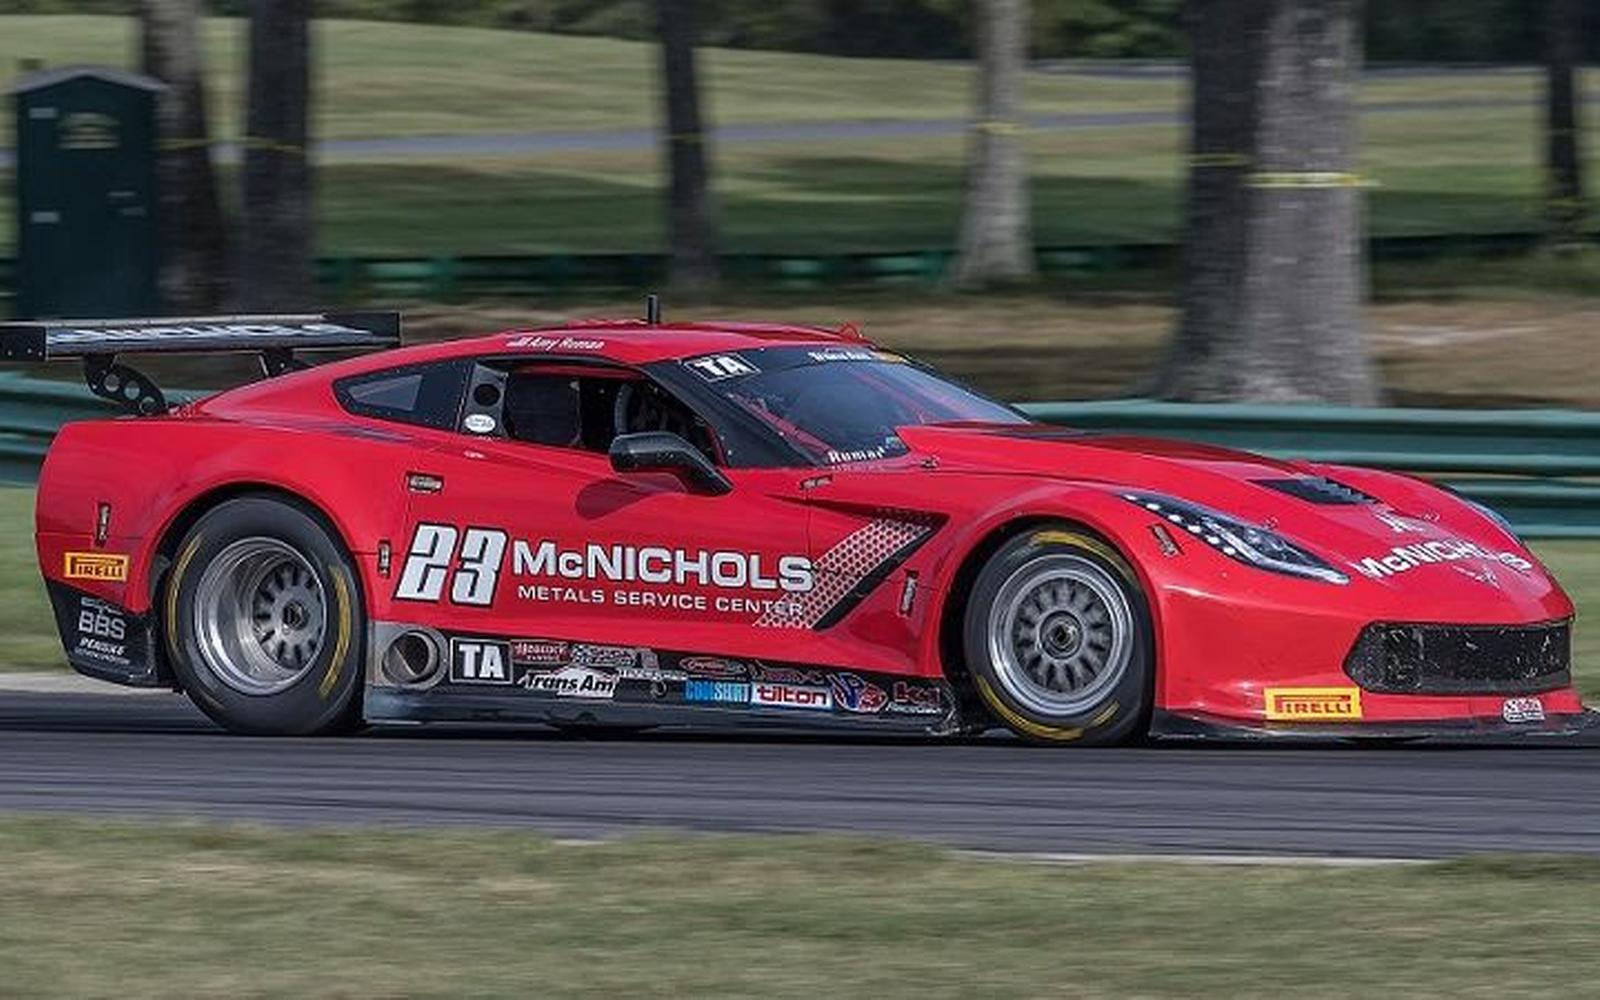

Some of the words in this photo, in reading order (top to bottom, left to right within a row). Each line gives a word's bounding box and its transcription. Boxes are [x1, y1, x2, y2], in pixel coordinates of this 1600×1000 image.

[694, 356, 750, 376] TA
[70, 556, 124, 578] PIRELLI
[394, 522, 508, 607] 23
[513, 540, 814, 592] McNICHOLS
[518, 585, 605, 604] METALS
[614, 590, 707, 610] SERVICE
[715, 597, 804, 616] CENTER
[79, 610, 127, 640] BBS
[458, 643, 505, 679] TA
[525, 672, 578, 690] Trans
[578, 674, 615, 692] Am
[1274, 695, 1352, 714] PIRELLI
